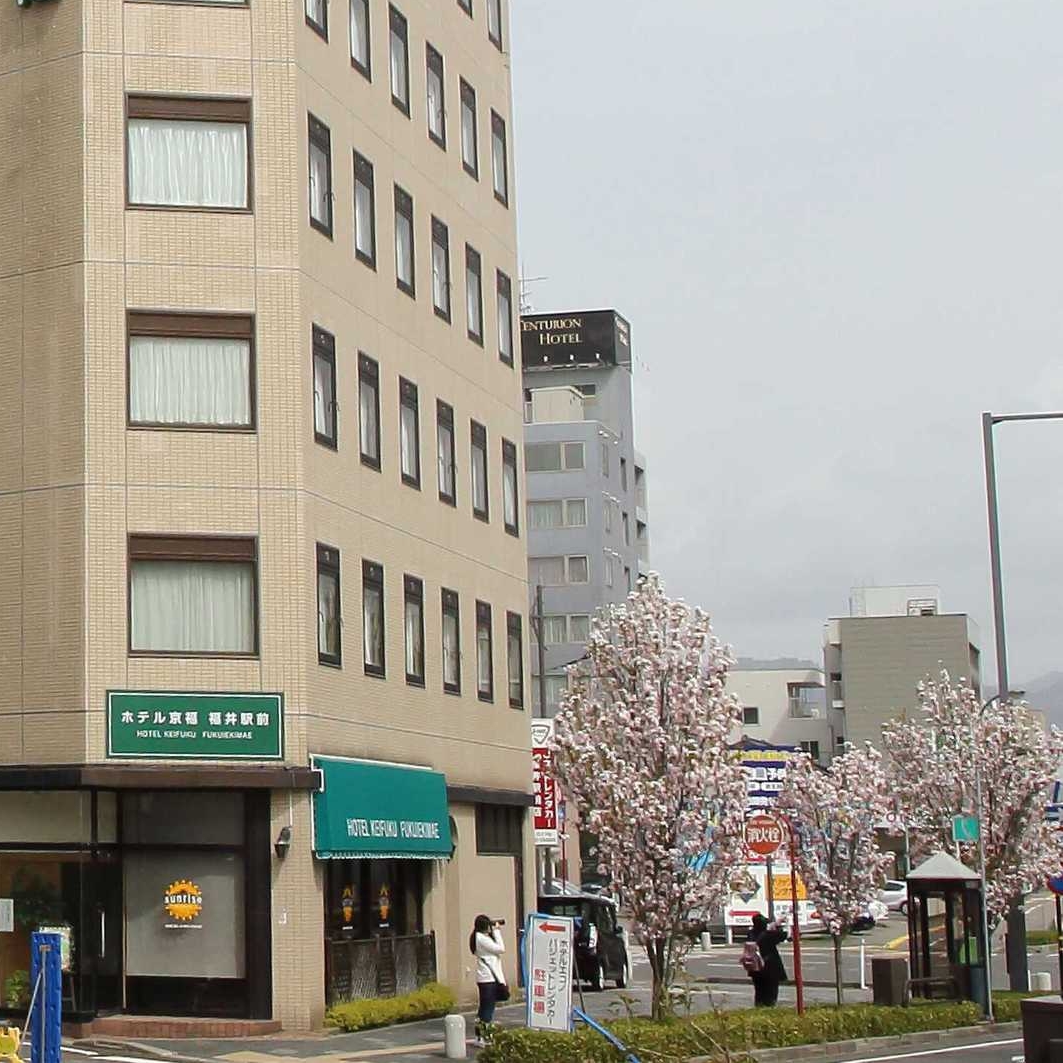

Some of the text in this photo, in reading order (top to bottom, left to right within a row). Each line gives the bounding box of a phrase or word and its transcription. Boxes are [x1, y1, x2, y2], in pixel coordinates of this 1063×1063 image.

[520, 318, 582, 331] ENTURION
[539, 333, 583, 345] HOTEL
[121, 710, 270, 726] ホテル京福 福井駅前
[136, 729, 161, 738] HOTEL
[163, 729, 196, 738] KEIFUKU
[346, 817, 370, 837] HOTEL
[164, 894, 203, 905] sunrise
